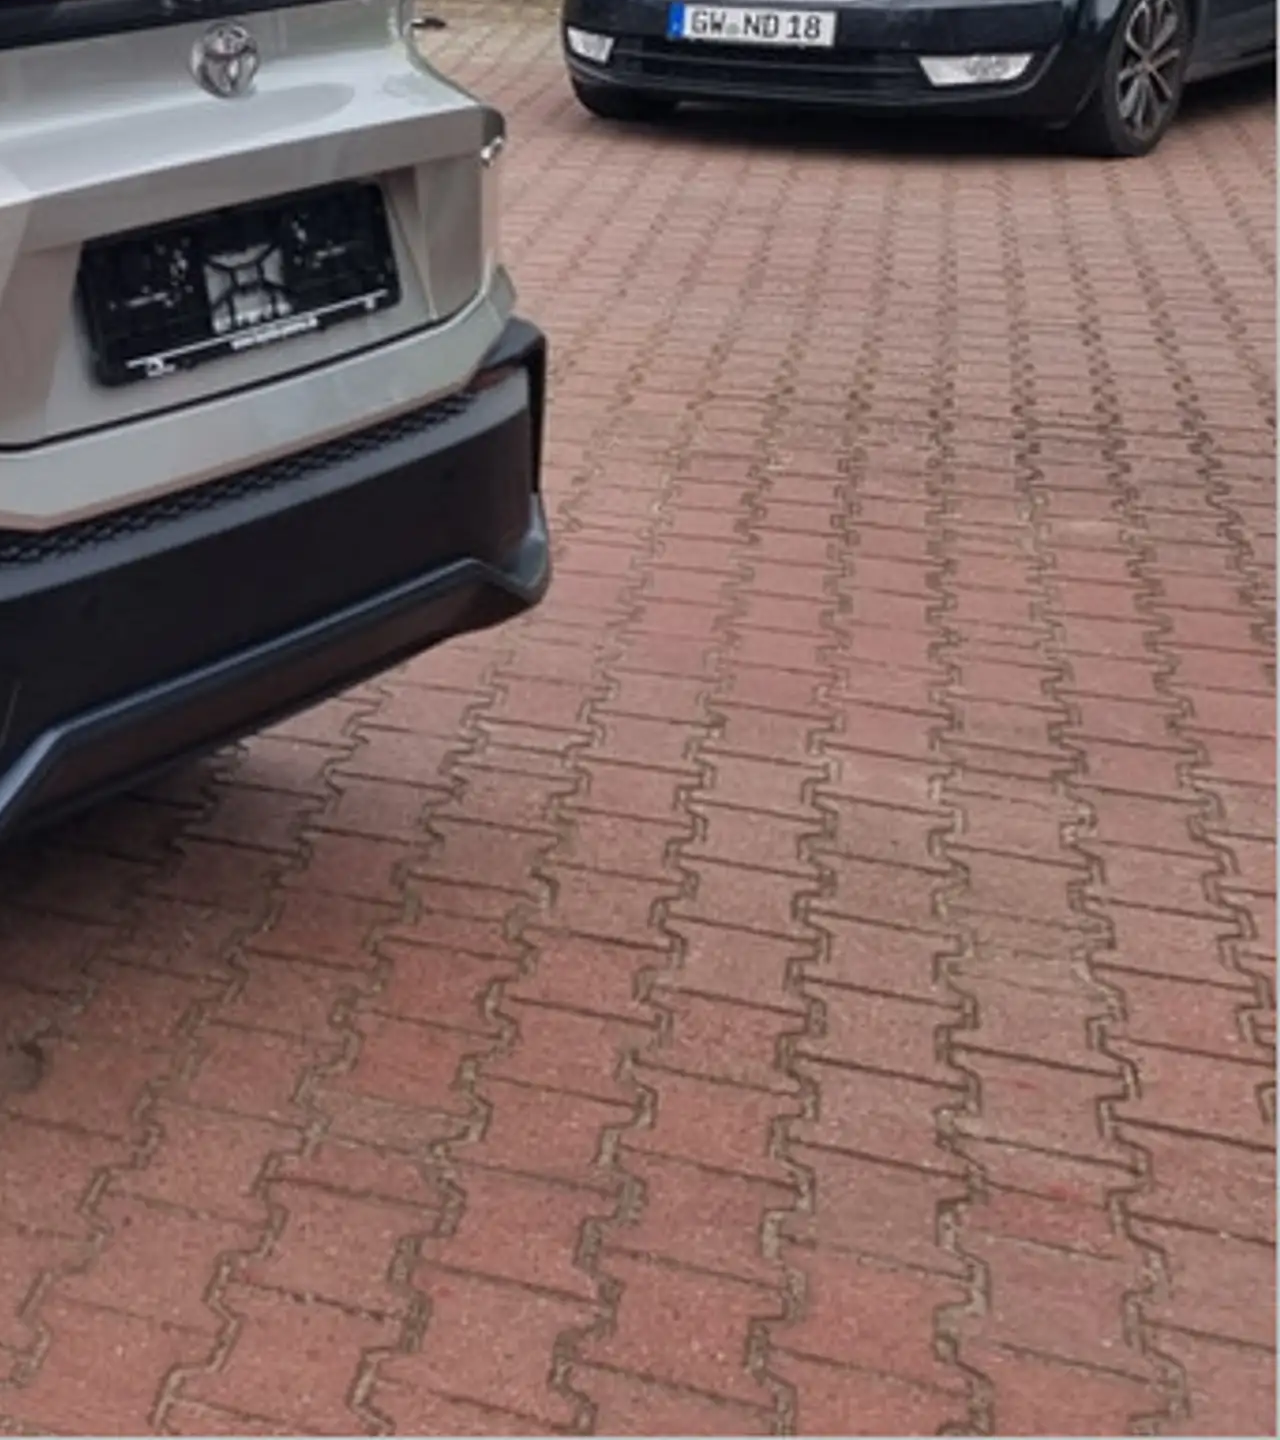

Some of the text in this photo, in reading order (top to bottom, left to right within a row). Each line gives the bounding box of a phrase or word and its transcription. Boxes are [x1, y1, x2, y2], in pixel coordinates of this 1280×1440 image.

[691, 9, 821, 40] GW ND 18
